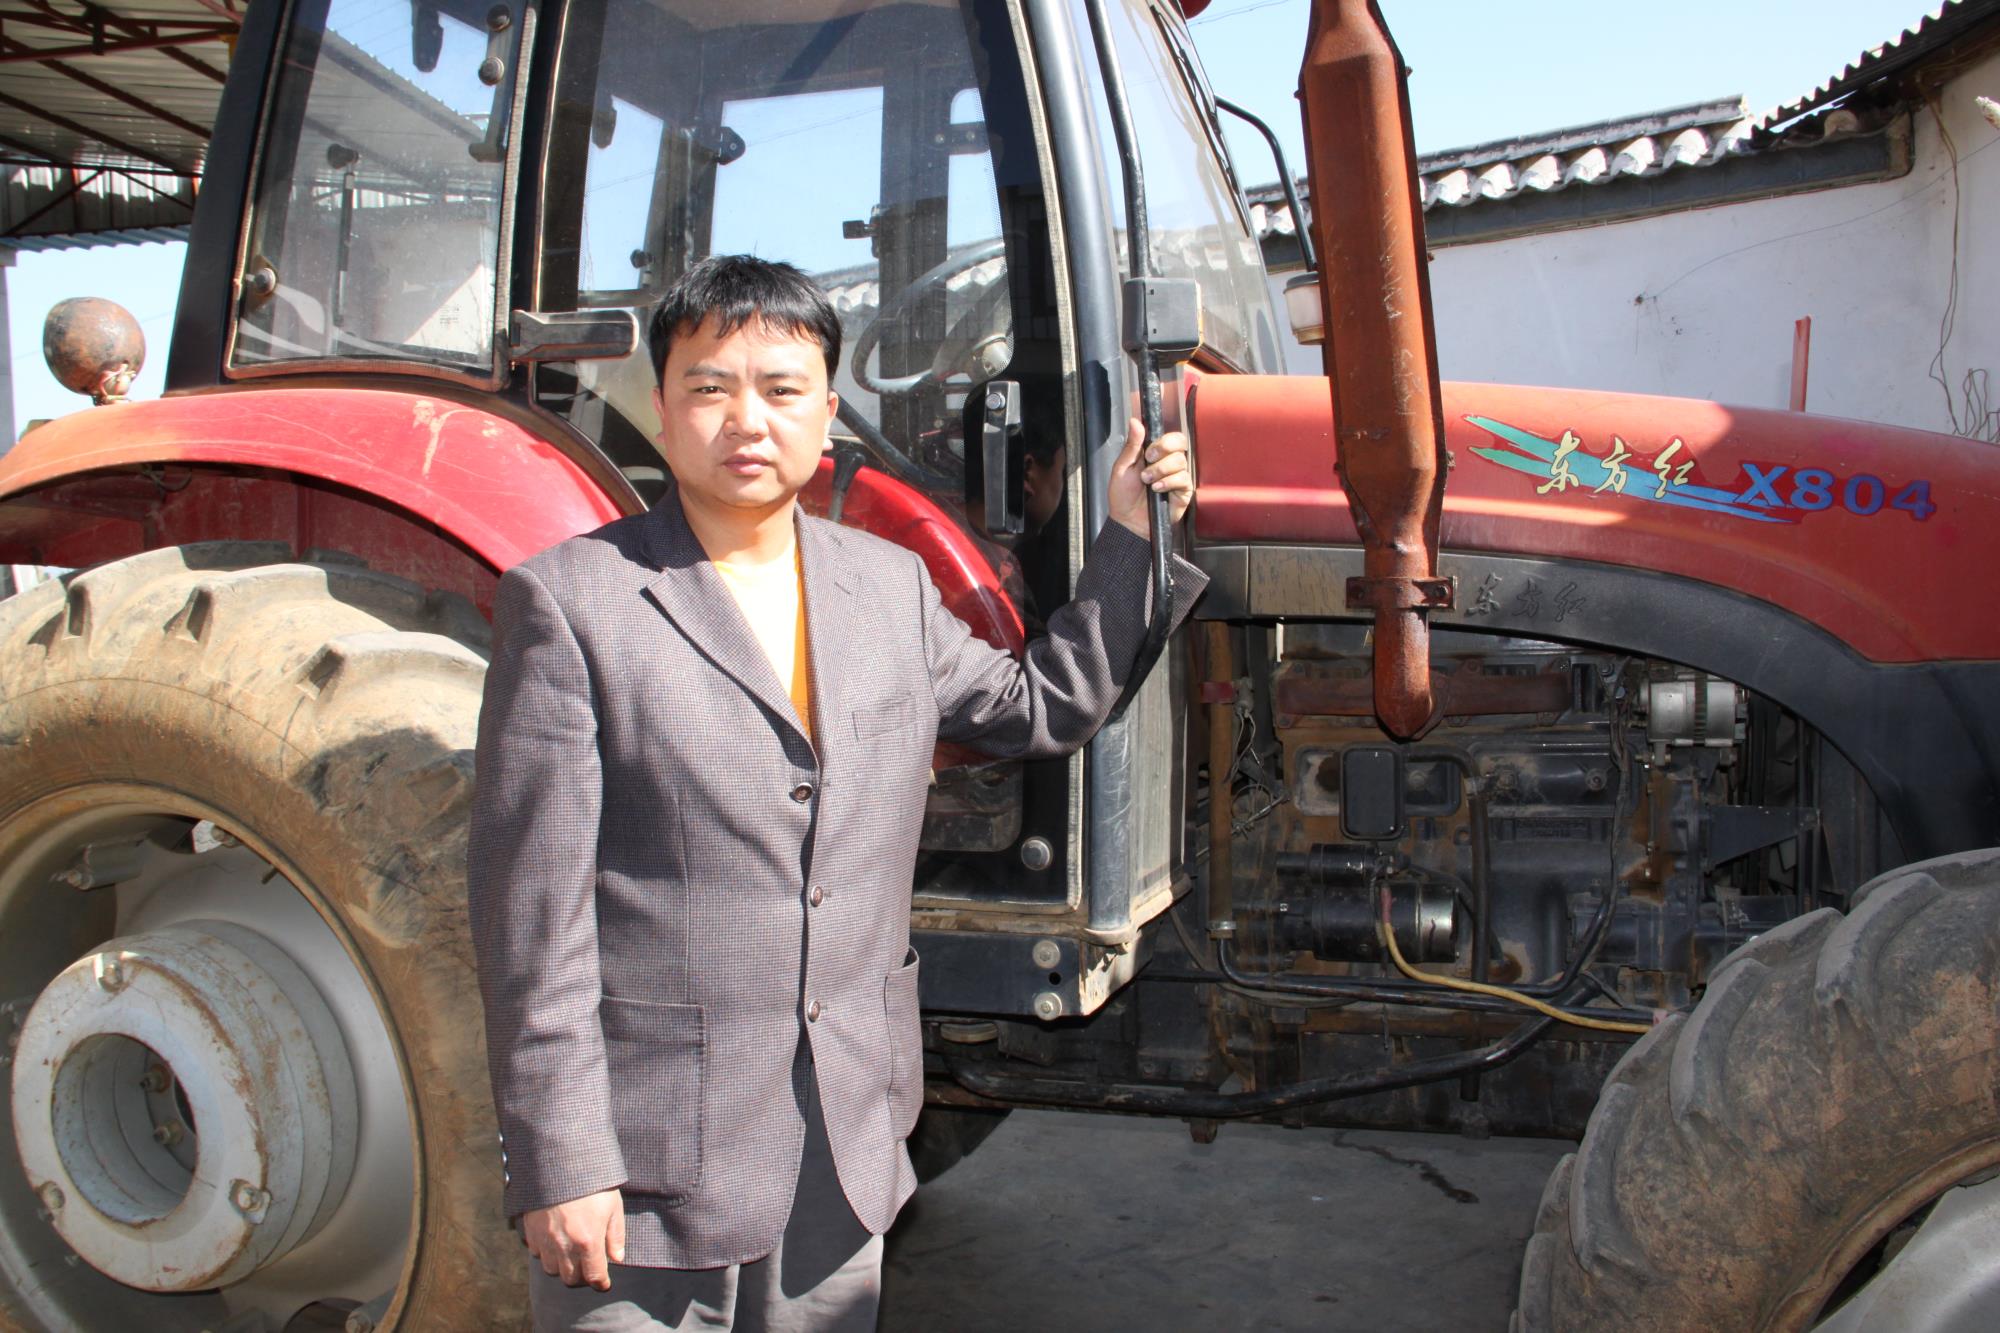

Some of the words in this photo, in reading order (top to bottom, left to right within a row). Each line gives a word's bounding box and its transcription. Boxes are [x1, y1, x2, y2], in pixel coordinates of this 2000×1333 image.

[1536, 430, 1695, 500] 东方红
[1735, 462, 1937, 521] X804
[1464, 571, 1586, 622] 东方红
